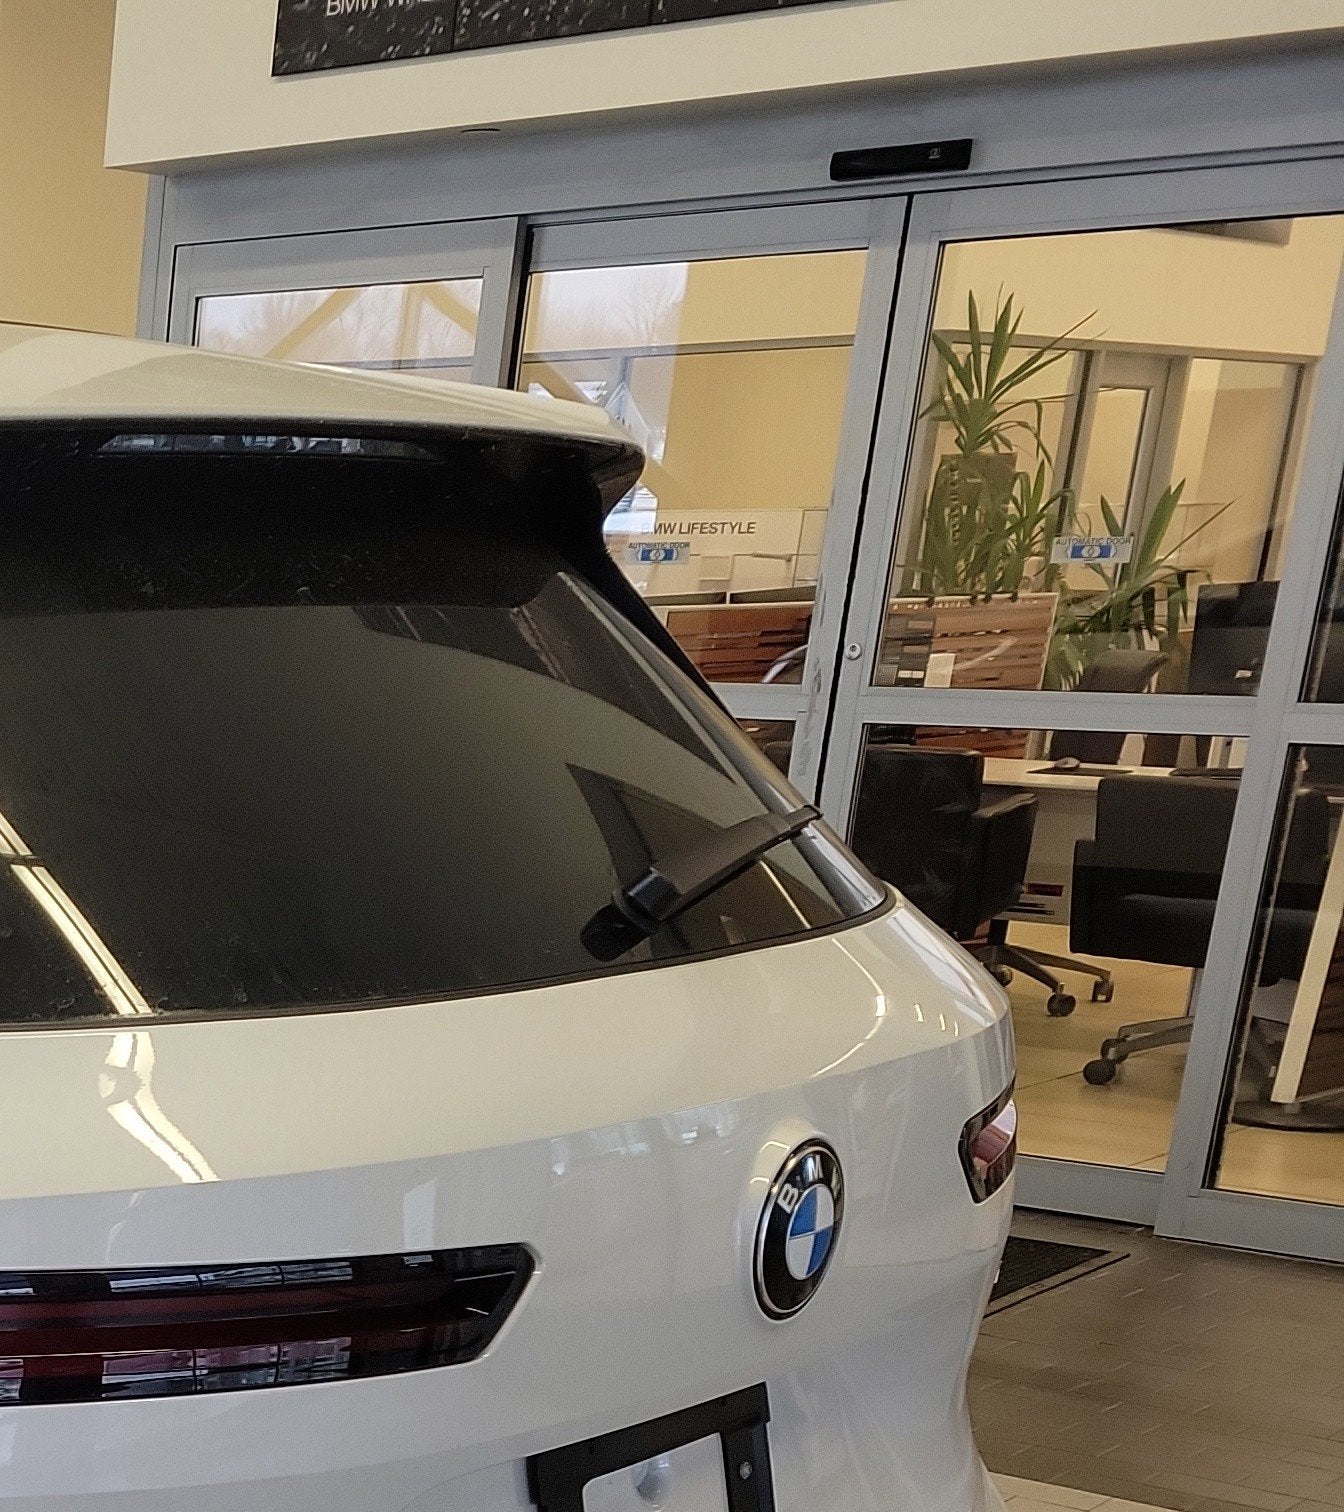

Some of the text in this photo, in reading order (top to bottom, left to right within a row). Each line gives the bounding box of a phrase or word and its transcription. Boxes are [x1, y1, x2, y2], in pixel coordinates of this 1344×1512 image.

[678, 521, 757, 535] LIFESTYLE
[628, 541, 691, 549] AUTOMATIC DOOR
[1106, 537, 1131, 545] DOOR
[776, 1154, 841, 1214] BMW
